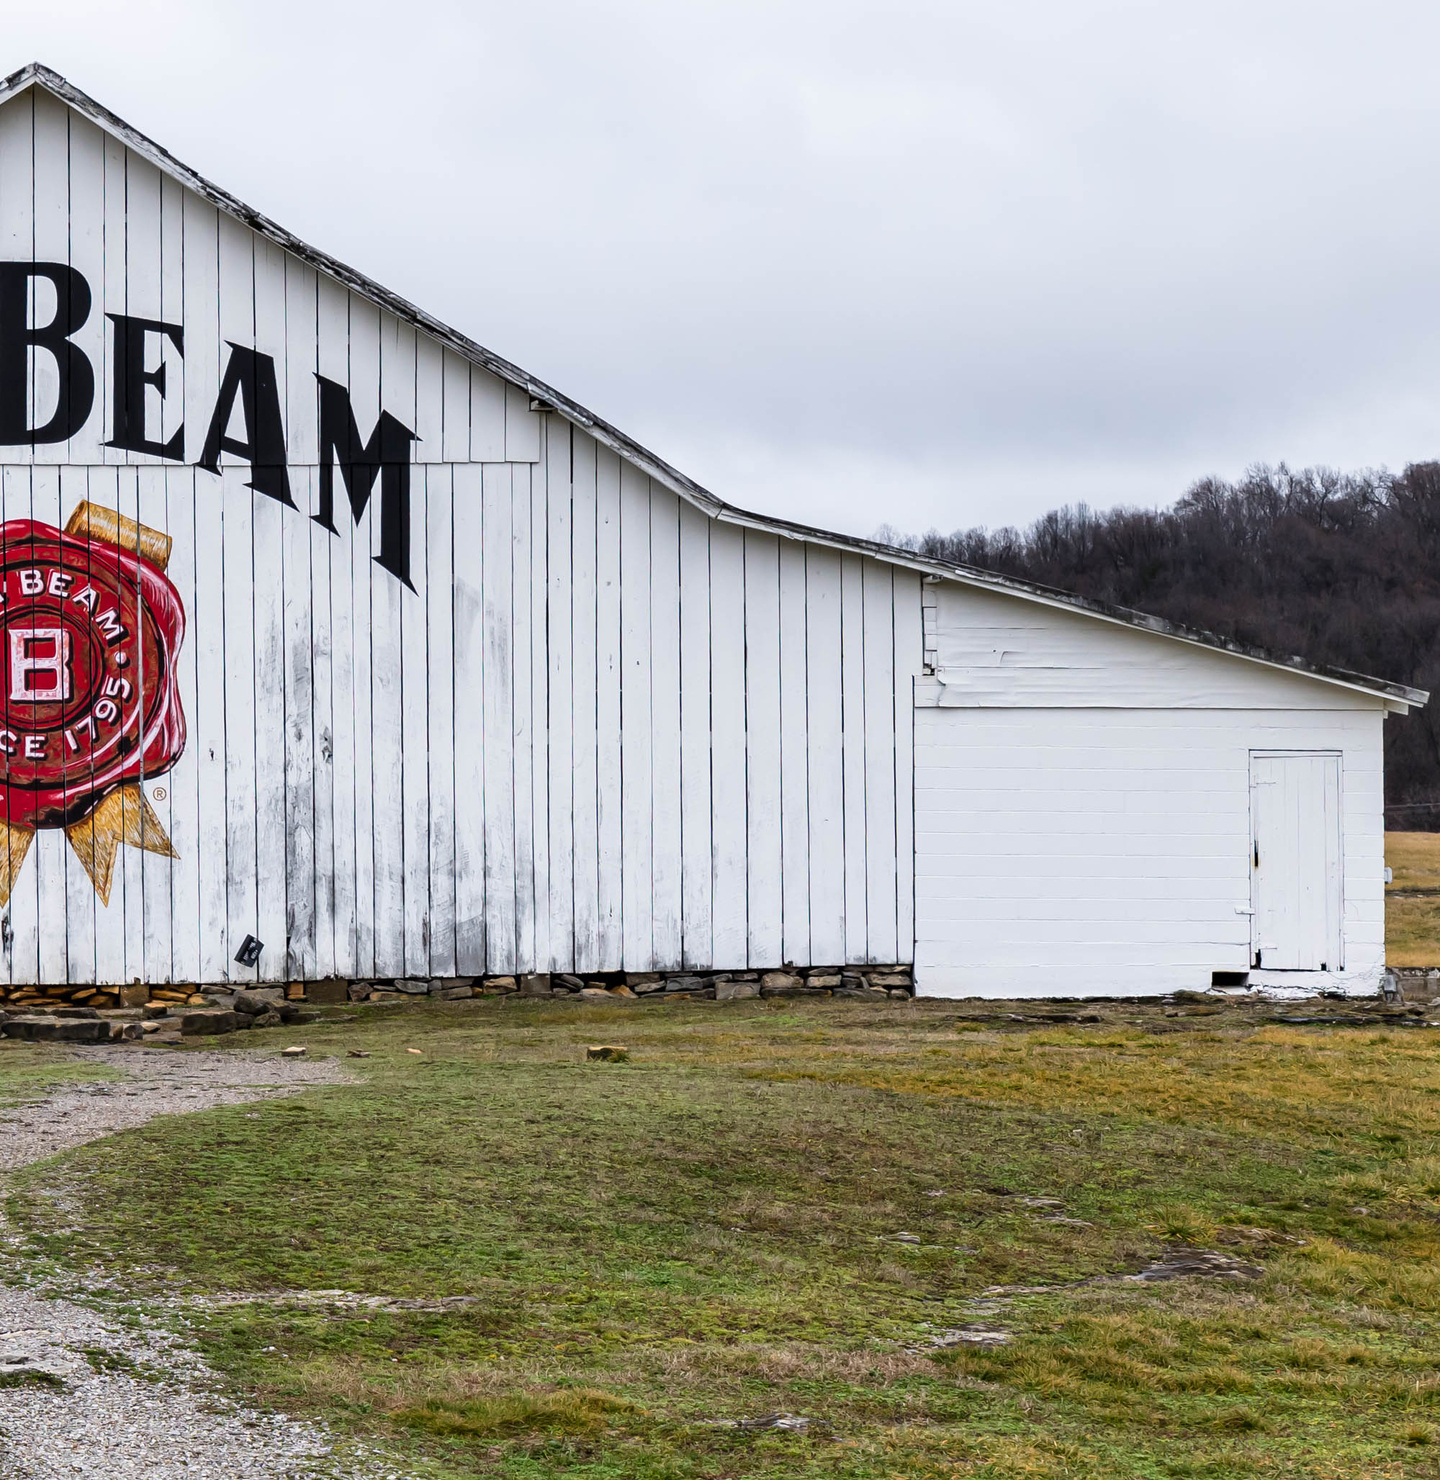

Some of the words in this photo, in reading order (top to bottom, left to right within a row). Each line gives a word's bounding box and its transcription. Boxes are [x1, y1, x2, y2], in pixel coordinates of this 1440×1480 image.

[19, 569, 127, 647] BEAM
[7, 628, 72, 702] B
[64, 676, 132, 752] 1795
